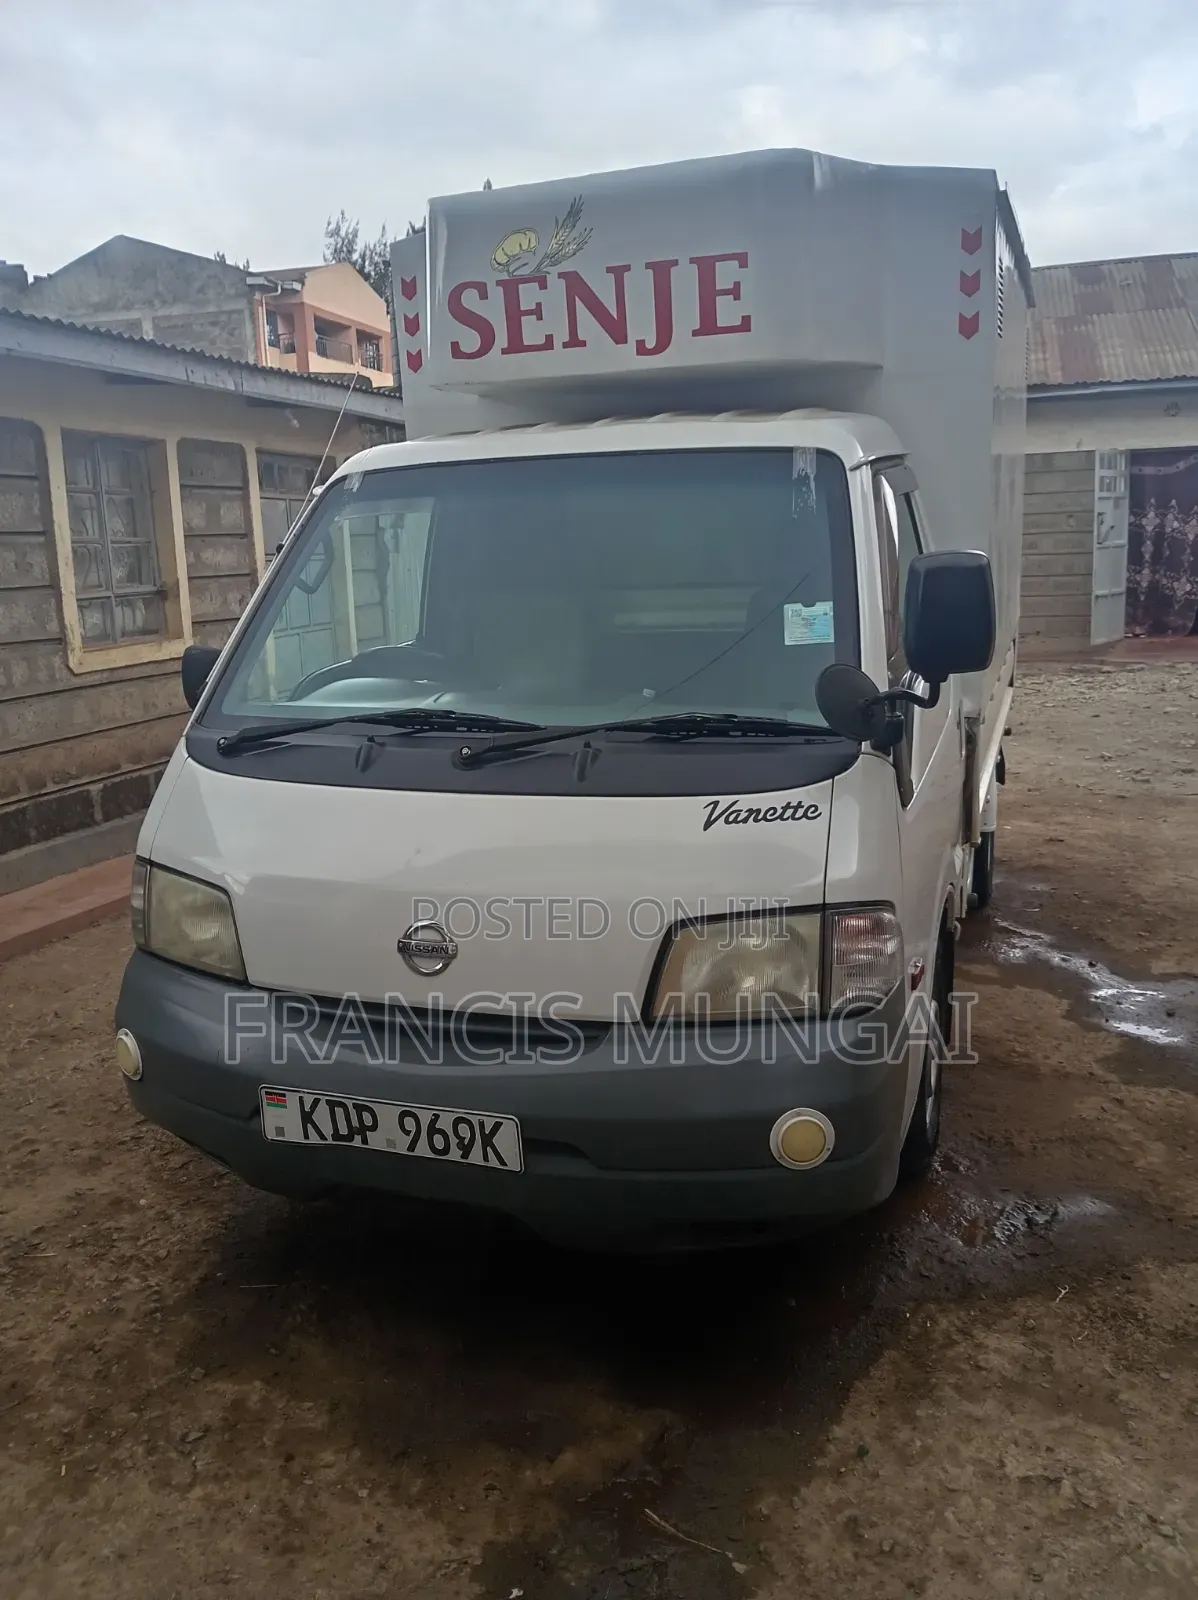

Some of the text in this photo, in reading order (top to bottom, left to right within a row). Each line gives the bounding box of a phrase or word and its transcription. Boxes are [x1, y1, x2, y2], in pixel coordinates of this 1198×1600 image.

[447, 252, 752, 360] SENJE
[703, 800, 822, 832] Vanette
[402, 942, 449, 954] NISSAN
[298, 1096, 508, 1166] KDP 969K
